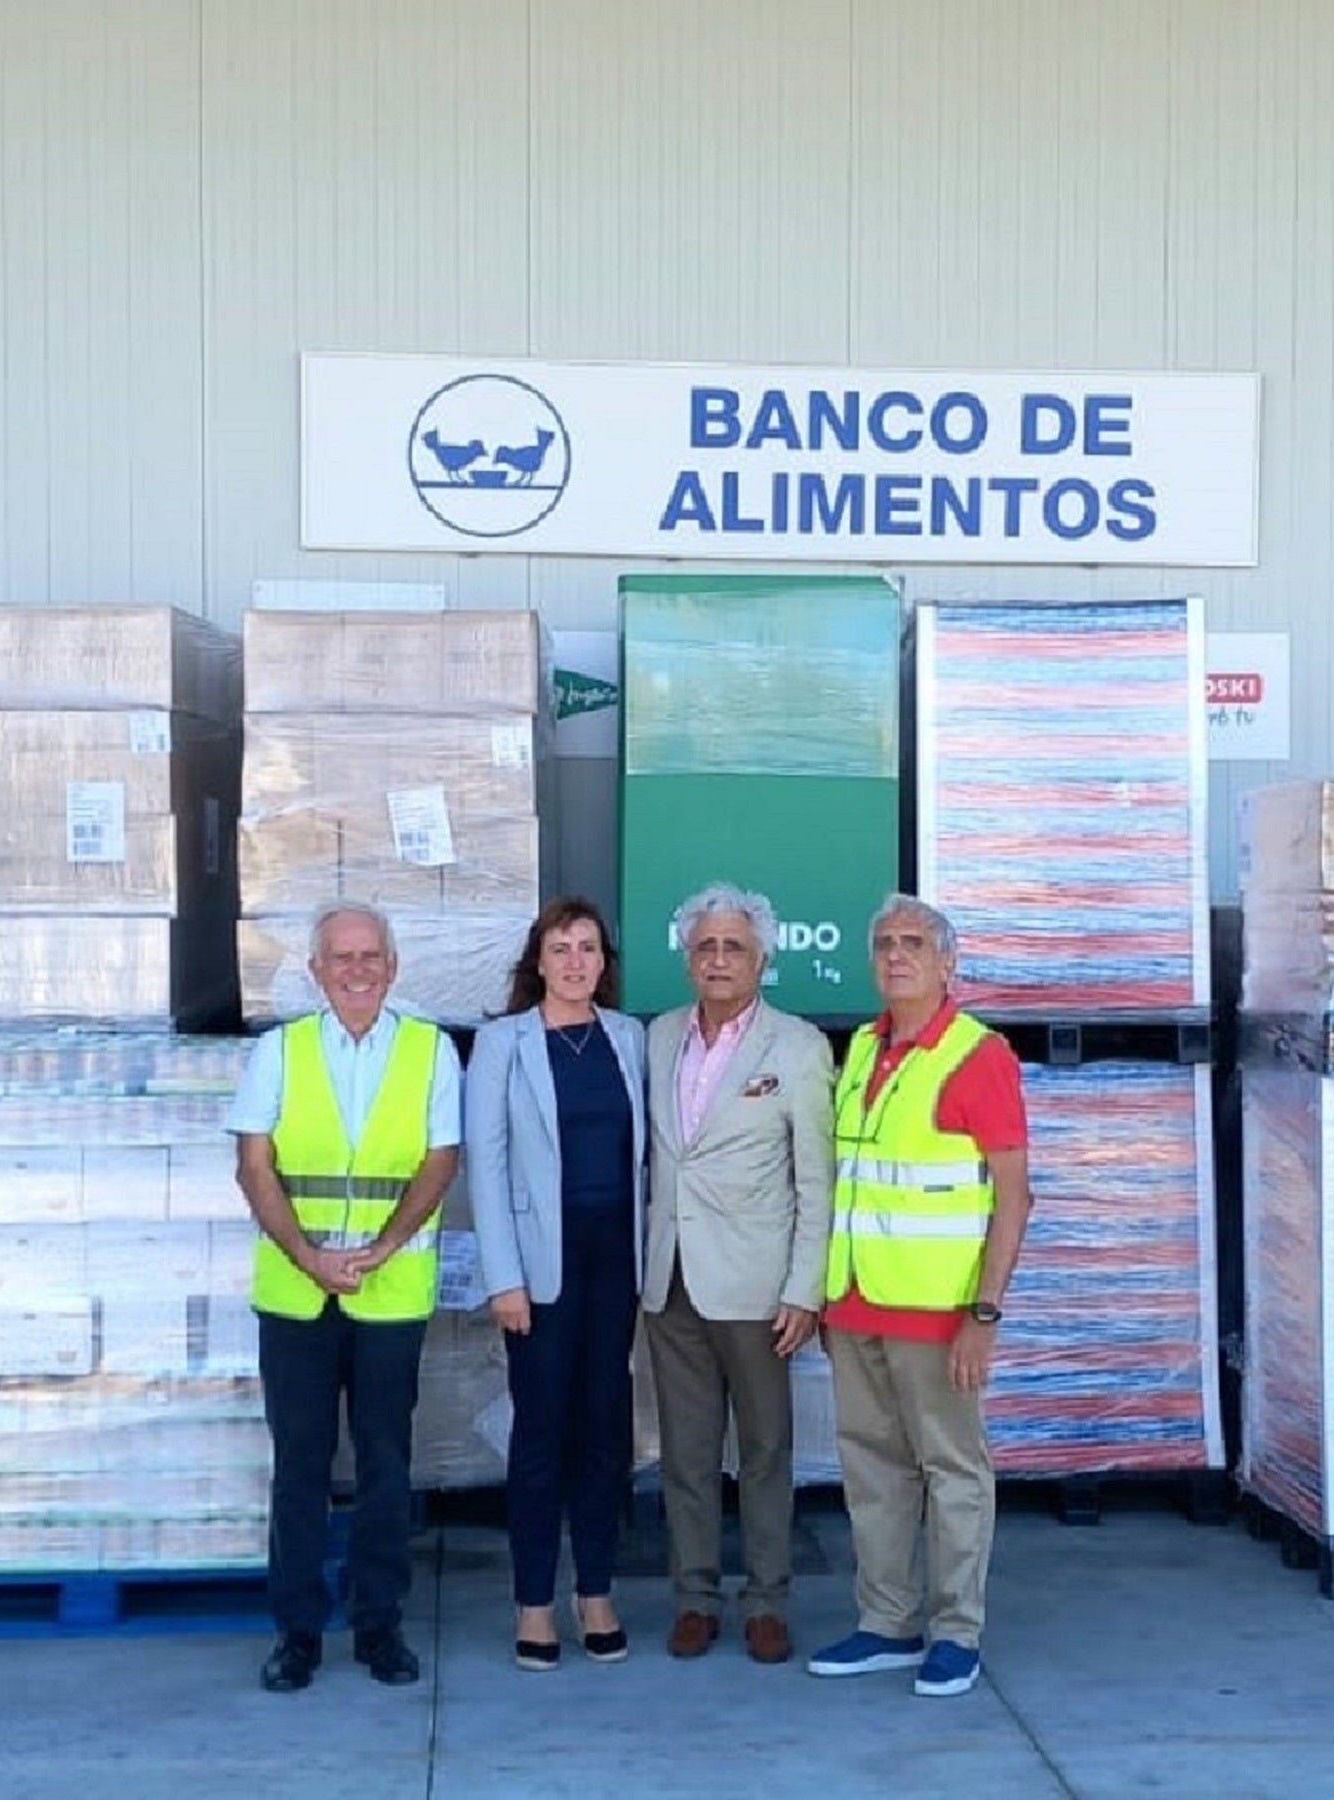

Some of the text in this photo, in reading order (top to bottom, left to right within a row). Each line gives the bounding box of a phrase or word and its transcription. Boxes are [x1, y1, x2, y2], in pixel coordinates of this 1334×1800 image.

[689, 386, 1132, 458] BANCO DE
[659, 470, 1158, 542] ALIMENTOS
[1205, 679, 1255, 697] OSKI
